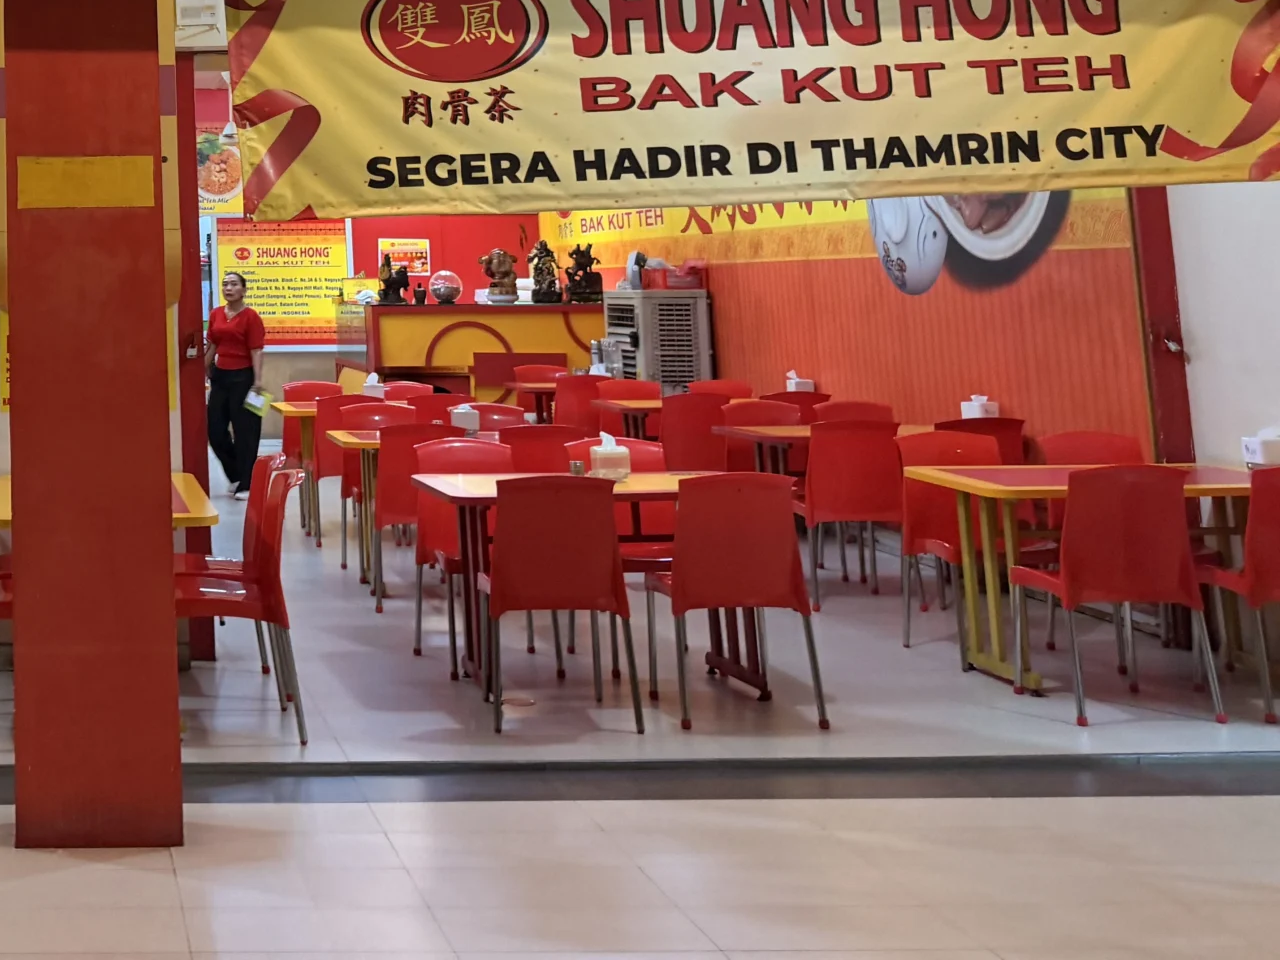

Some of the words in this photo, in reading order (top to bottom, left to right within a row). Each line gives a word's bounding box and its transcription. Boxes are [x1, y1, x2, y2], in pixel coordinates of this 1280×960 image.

[387, 0, 516, 50] 雙鳳
[401, 85, 522, 127] 肉骨茶
[579, 69, 759, 113] BAK
[781, 62, 946, 103] KUT
[967, 54, 1130, 96] TEH
[366, 150, 561, 190] SEGERA
[572, 143, 733, 182] HADIR
[747, 140, 798, 176] DI
[810, 130, 1041, 173] THAMRIN
[1055, 123, 1165, 161] CITY
[580, 216, 605, 234] BAK
[608, 212, 633, 230] KUT
[636, 208, 664, 228] TEH
[256, 246, 297, 258] SHUANG
[300, 246, 330, 258] HONG
